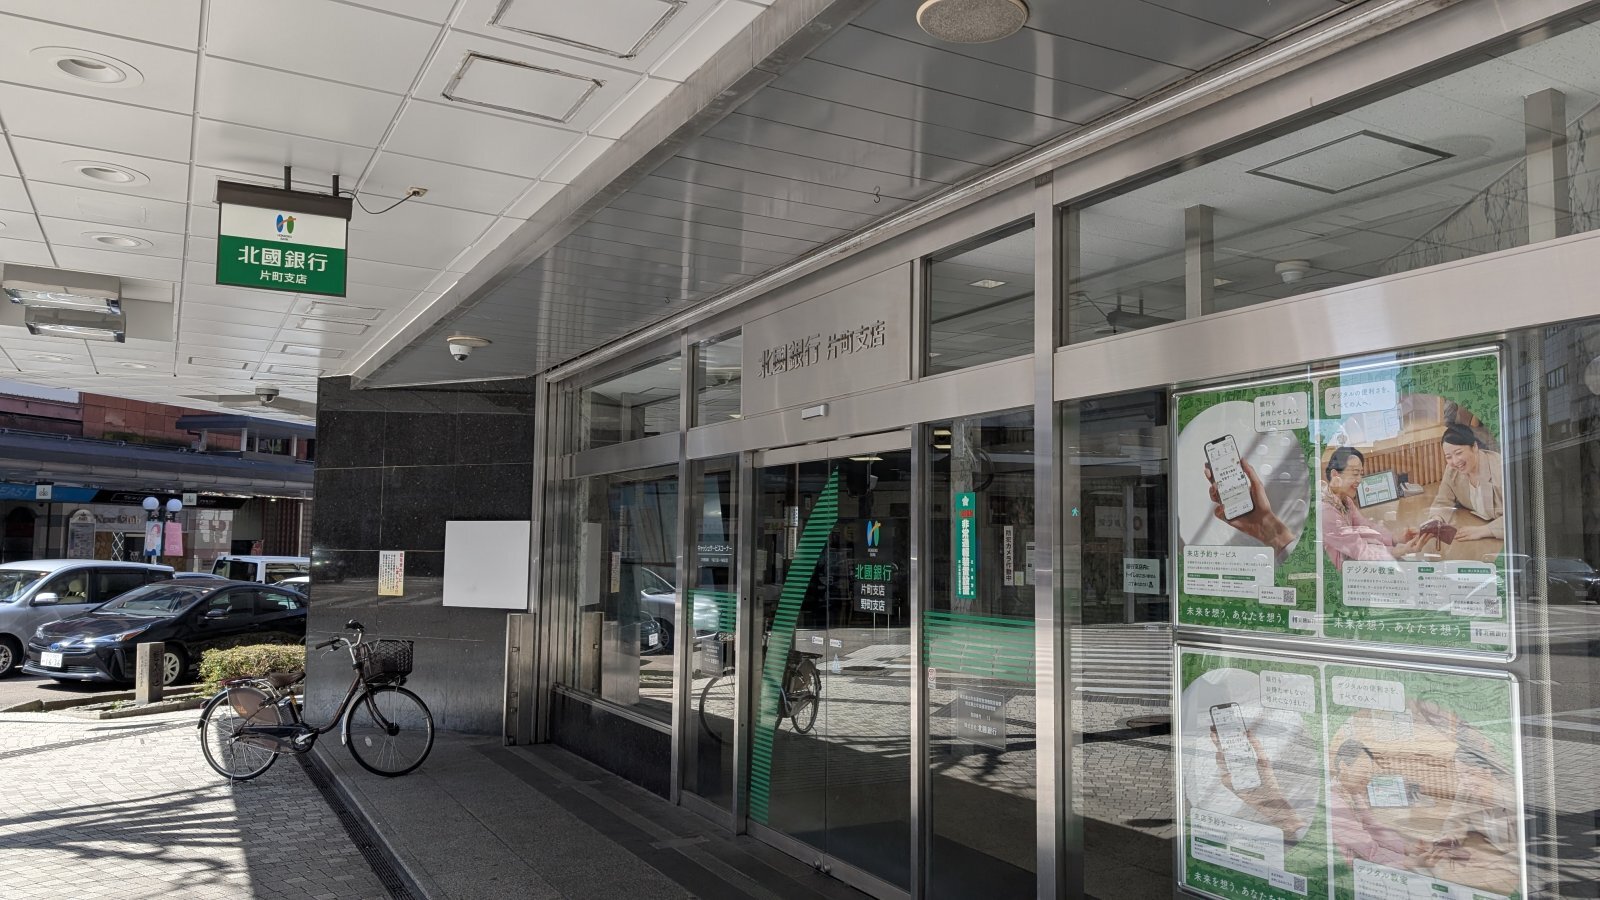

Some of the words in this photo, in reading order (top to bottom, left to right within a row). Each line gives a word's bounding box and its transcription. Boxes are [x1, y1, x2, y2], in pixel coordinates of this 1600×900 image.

[238, 245, 328, 271] 北國銀行
[260, 270, 307, 284] 片町支店
[757, 333, 821, 379] 北國銀行
[827, 320, 886, 361] 片町支店
[1260, 408, 1299, 417] お待たせしない
[1187, 549, 1237, 558] 来店予約サービス
[855, 563, 892, 582] 北國銀行
[1346, 566, 1396, 575] デジタル教室
[860, 583, 886, 597] 片町支店
[860, 598, 886, 612] 野町支店
[1186, 605, 1286, 624] 未来を想う、あなたを想う。
[1334, 619, 1467, 638] 未来を想う、あなたを想う。
